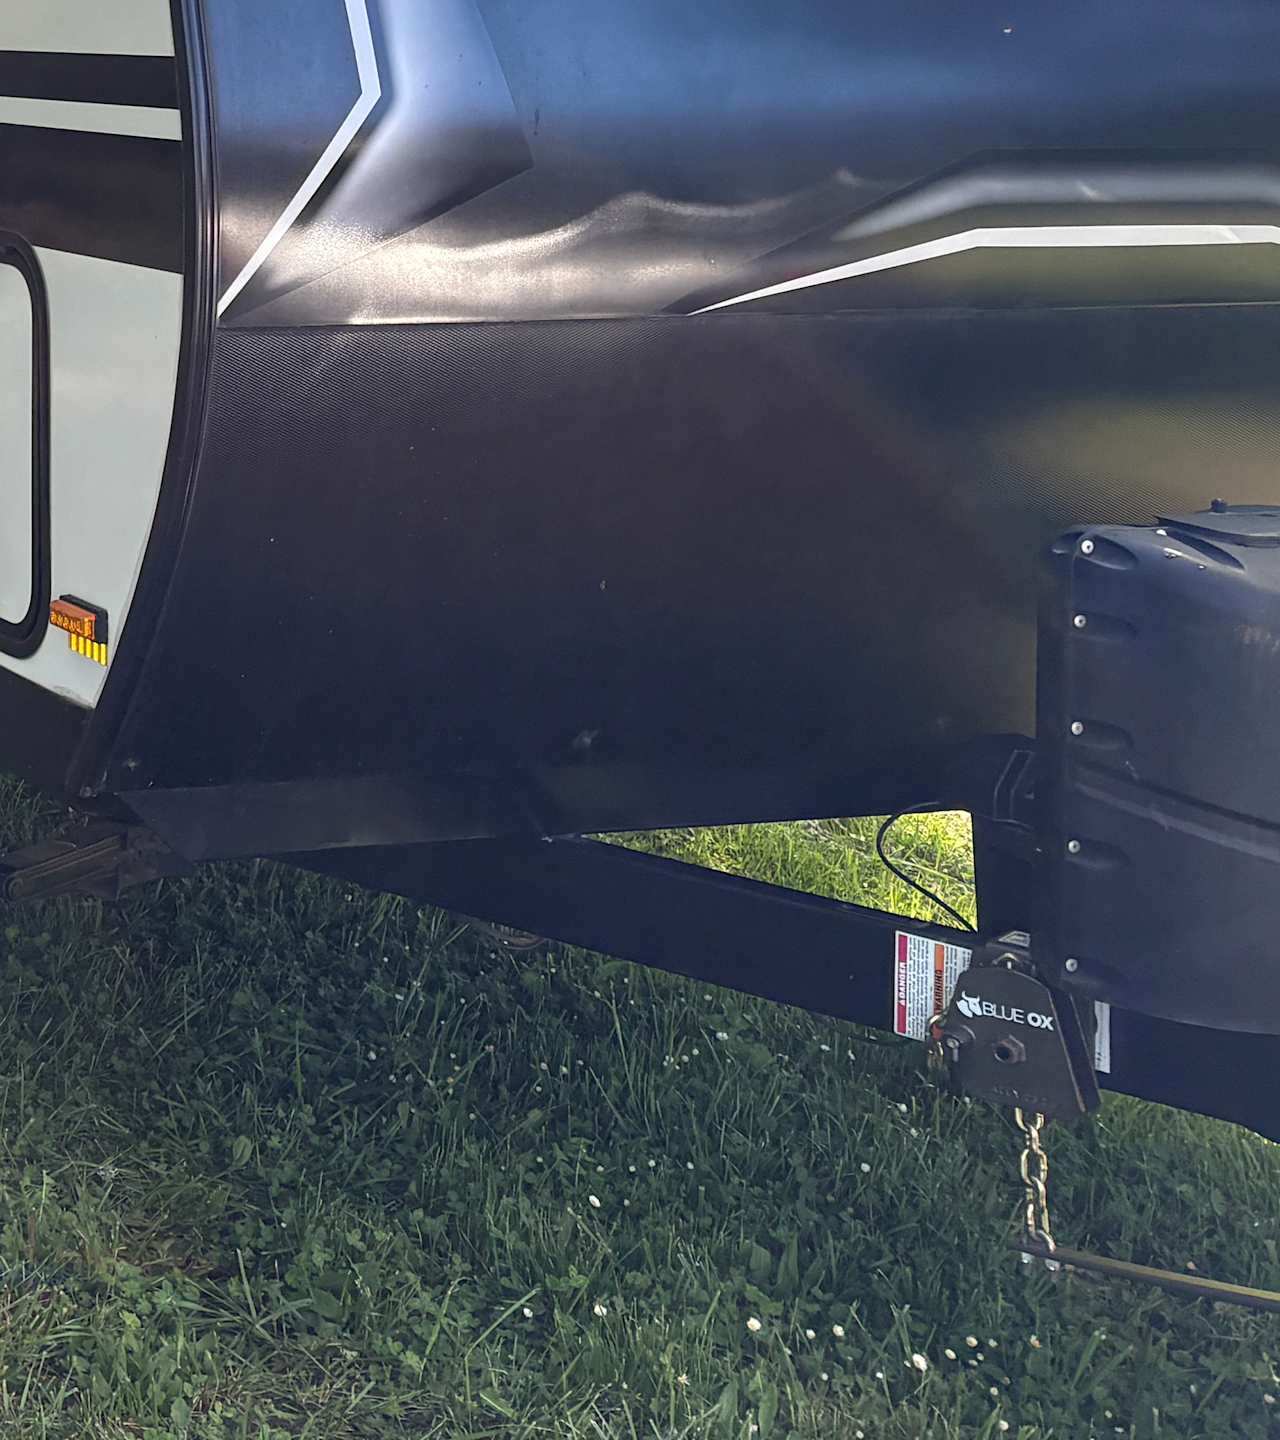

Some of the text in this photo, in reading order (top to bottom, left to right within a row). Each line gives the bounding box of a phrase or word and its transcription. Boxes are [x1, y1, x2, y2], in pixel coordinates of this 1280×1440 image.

[899, 962, 907, 999] DANGER
[983, 1001, 1055, 1031] BLUE OX
